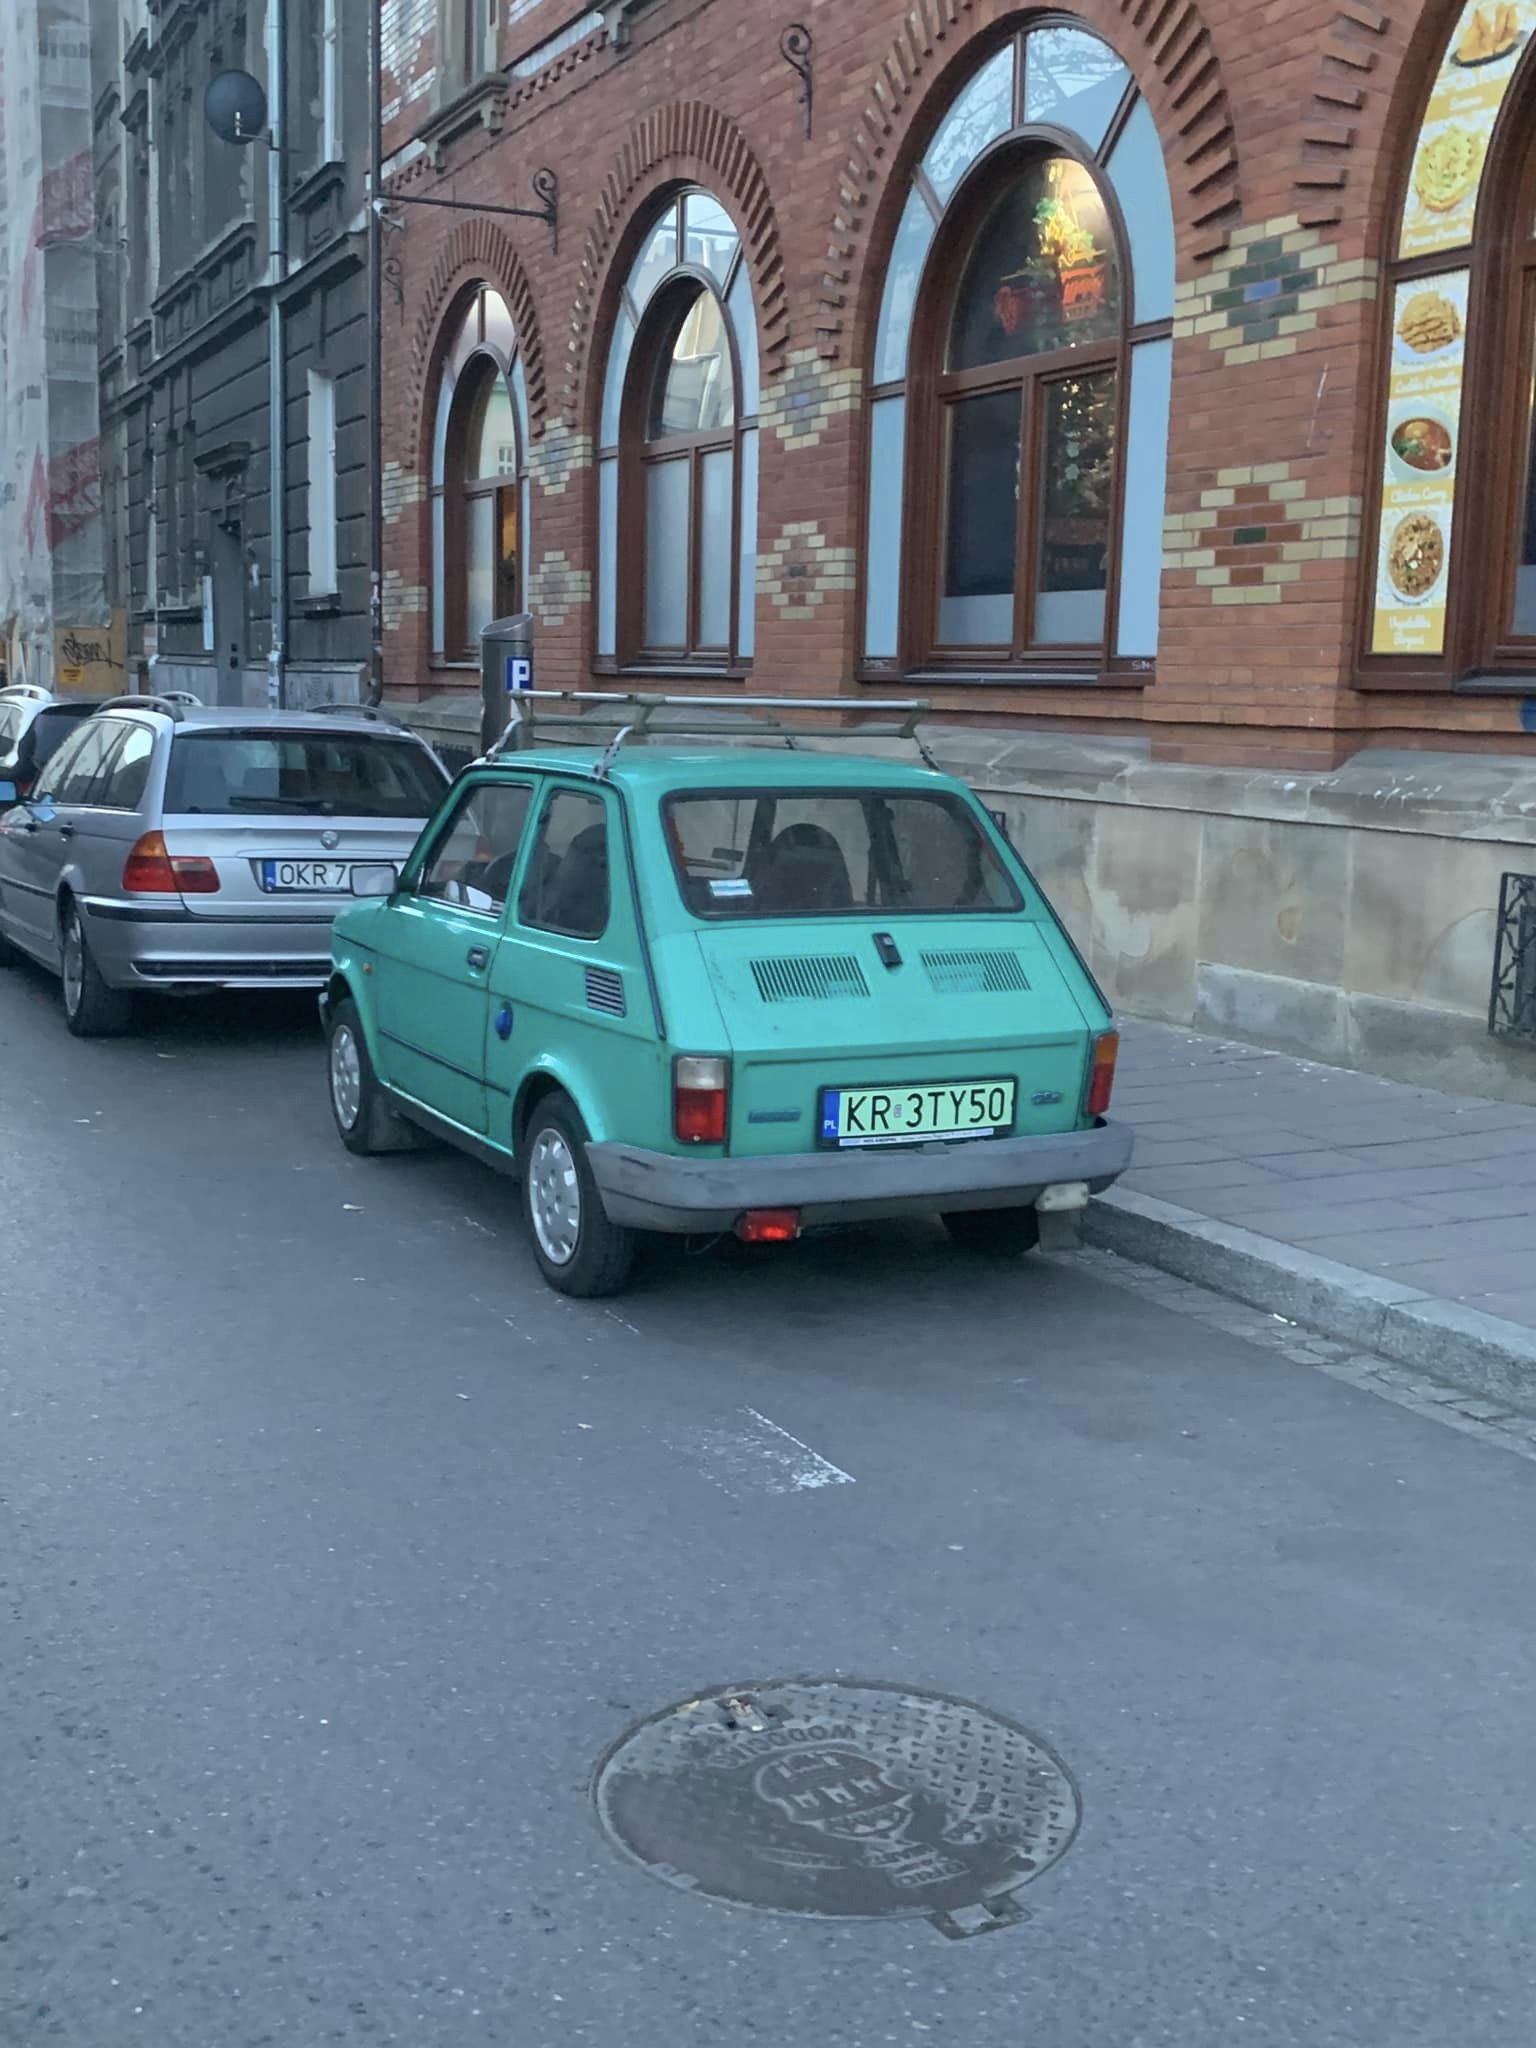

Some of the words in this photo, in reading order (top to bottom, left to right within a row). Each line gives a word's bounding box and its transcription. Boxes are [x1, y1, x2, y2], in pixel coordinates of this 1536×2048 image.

[512, 660, 530, 689] P
[280, 864, 328, 885] OKR
[847, 1095, 891, 1132] KR
[905, 1087, 1006, 1128] 3TY50
[824, 1119, 837, 1130] PL
